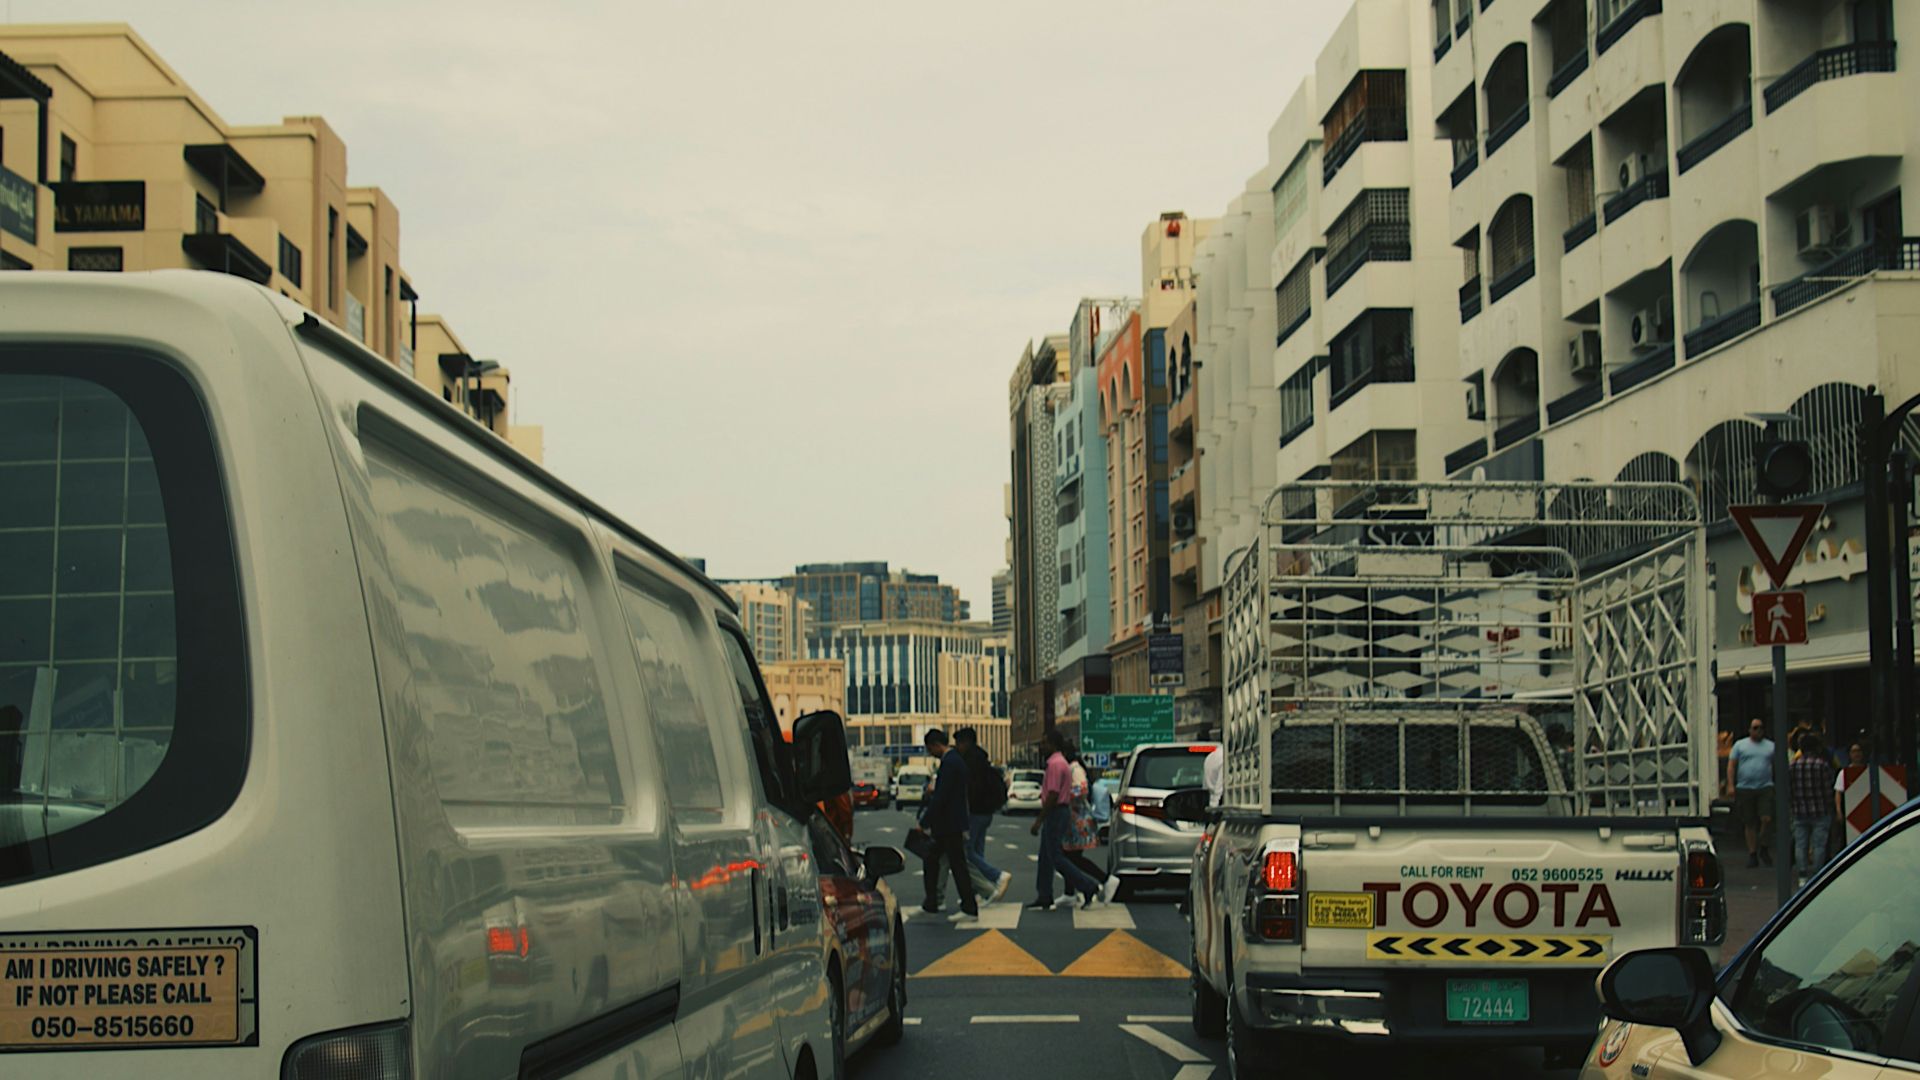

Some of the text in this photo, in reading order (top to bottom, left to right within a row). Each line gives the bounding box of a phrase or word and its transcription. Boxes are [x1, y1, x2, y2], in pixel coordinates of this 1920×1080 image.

[75, 204, 142, 223] YAMAMA
[1400, 865, 1484, 879] CALL FOR RENT
[1512, 868, 1604, 881] 052 9600525
[1615, 869, 1674, 881] HILUX
[1363, 881, 1621, 928] TOYOTA
[5, 955, 225, 979] AM I DRIVING SAFELY ?
[16, 982, 212, 1006] IF NOT PLEASE CALL
[1462, 997, 1513, 1018] 72444
[31, 1015, 194, 1038] 050-8515660
